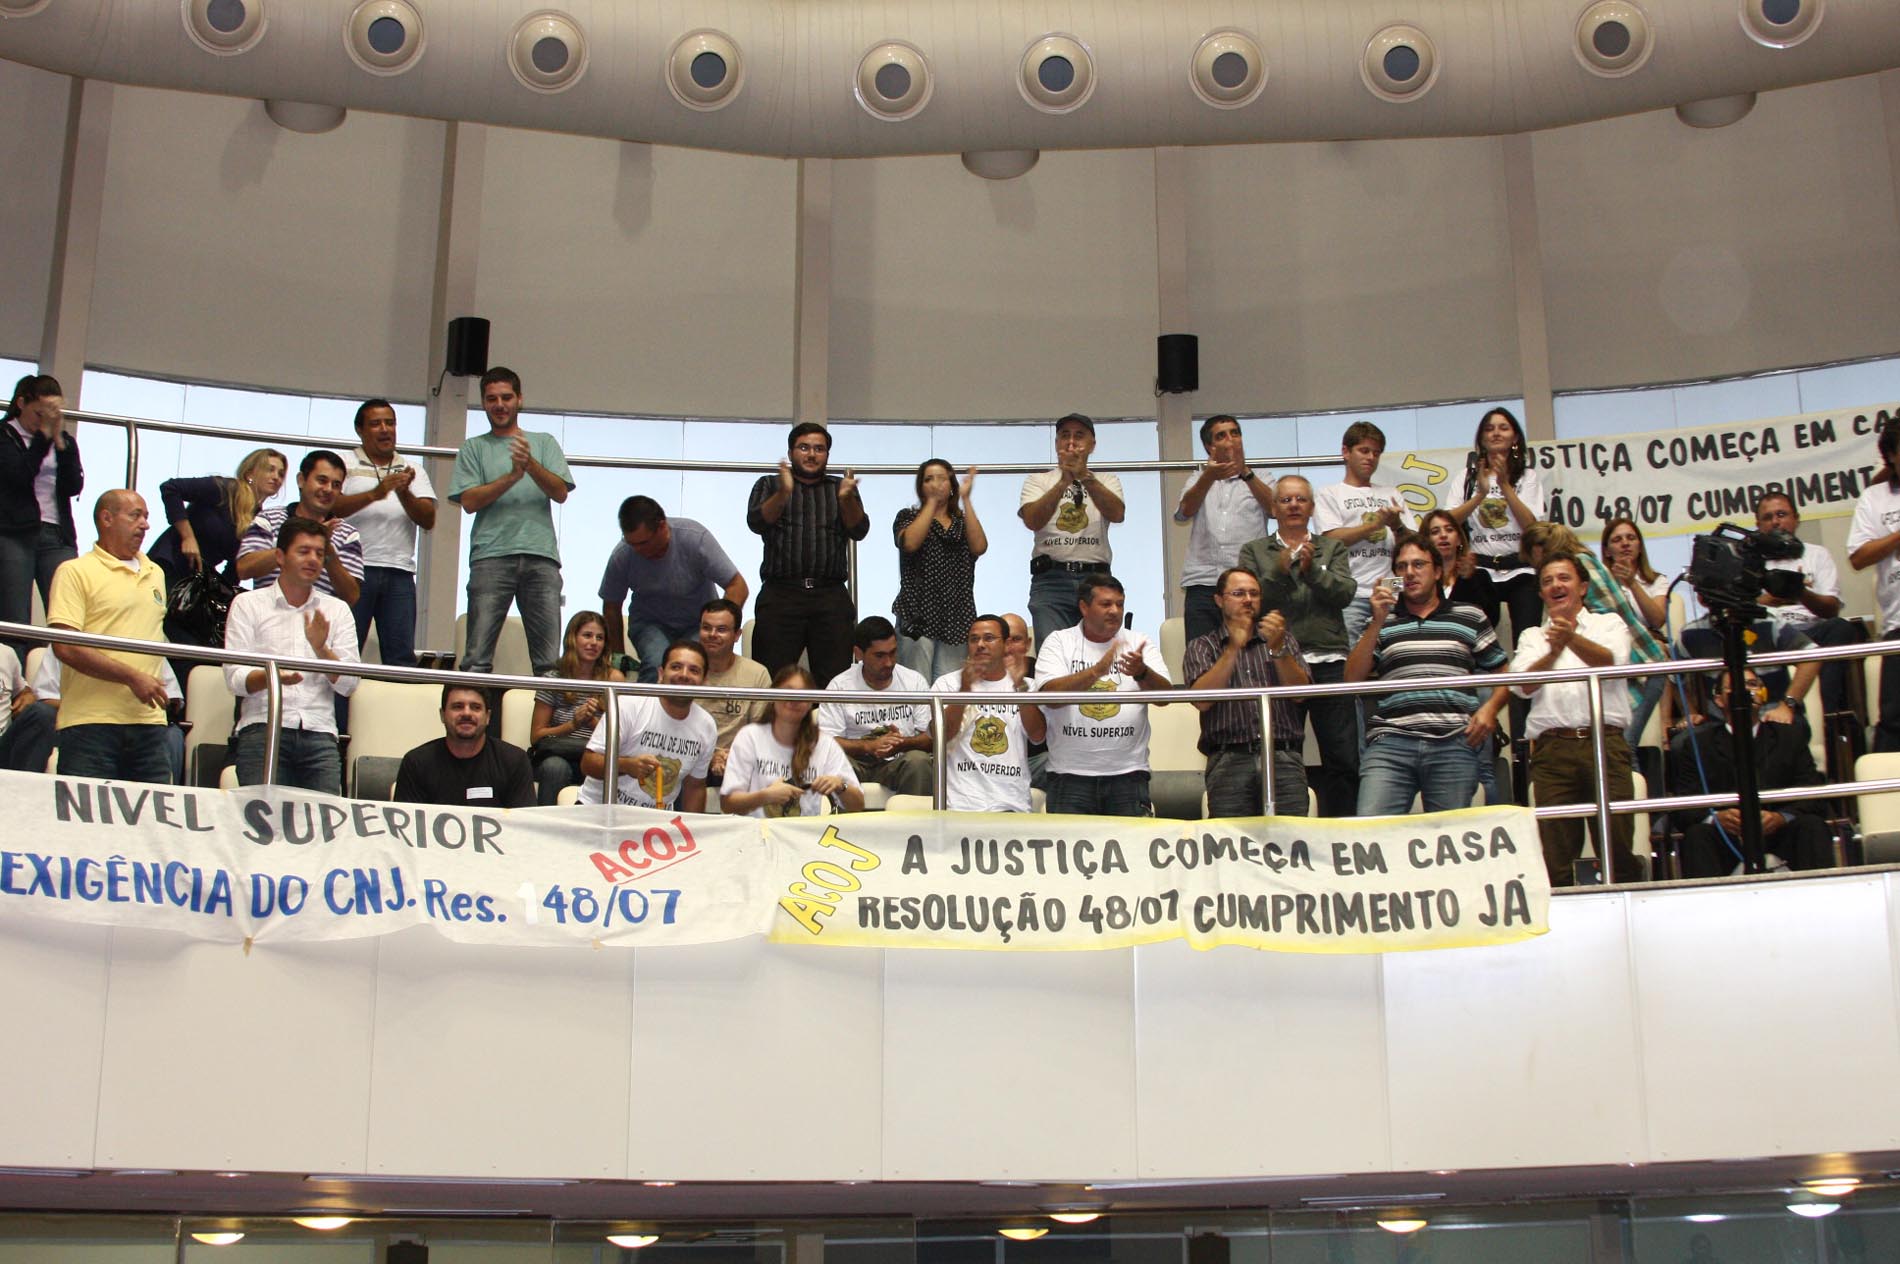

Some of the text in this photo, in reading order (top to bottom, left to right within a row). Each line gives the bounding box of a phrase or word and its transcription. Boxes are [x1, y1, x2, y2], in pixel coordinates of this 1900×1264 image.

[1647, 427, 1780, 469] COMEÇA
[1794, 419, 1836, 448] EM
[640, 731, 667, 750] OFICIAL
[667, 736, 678, 753] DE
[1062, 723, 1135, 738] NÍVEL SUPERIOR
[980, 762, 1022, 777] SUPERIOR
[54, 780, 505, 855] NÍVEL SUPERIOR
[588, 815, 698, 883] ACOJ
[901, 826, 1517, 880] A JUSTIÇA COMEÇA EM CASA
[0, 850, 233, 918] EXIGÊNCIA
[250, 872, 309, 919] DO
[323, 866, 417, 916] CNJ.
[423, 878, 508, 923] Res.
[779, 824, 882, 936] ACOJ
[858, 873, 1532, 943] RESOLUÇÃO 48/07 CUMPRIMENTO JÁ
